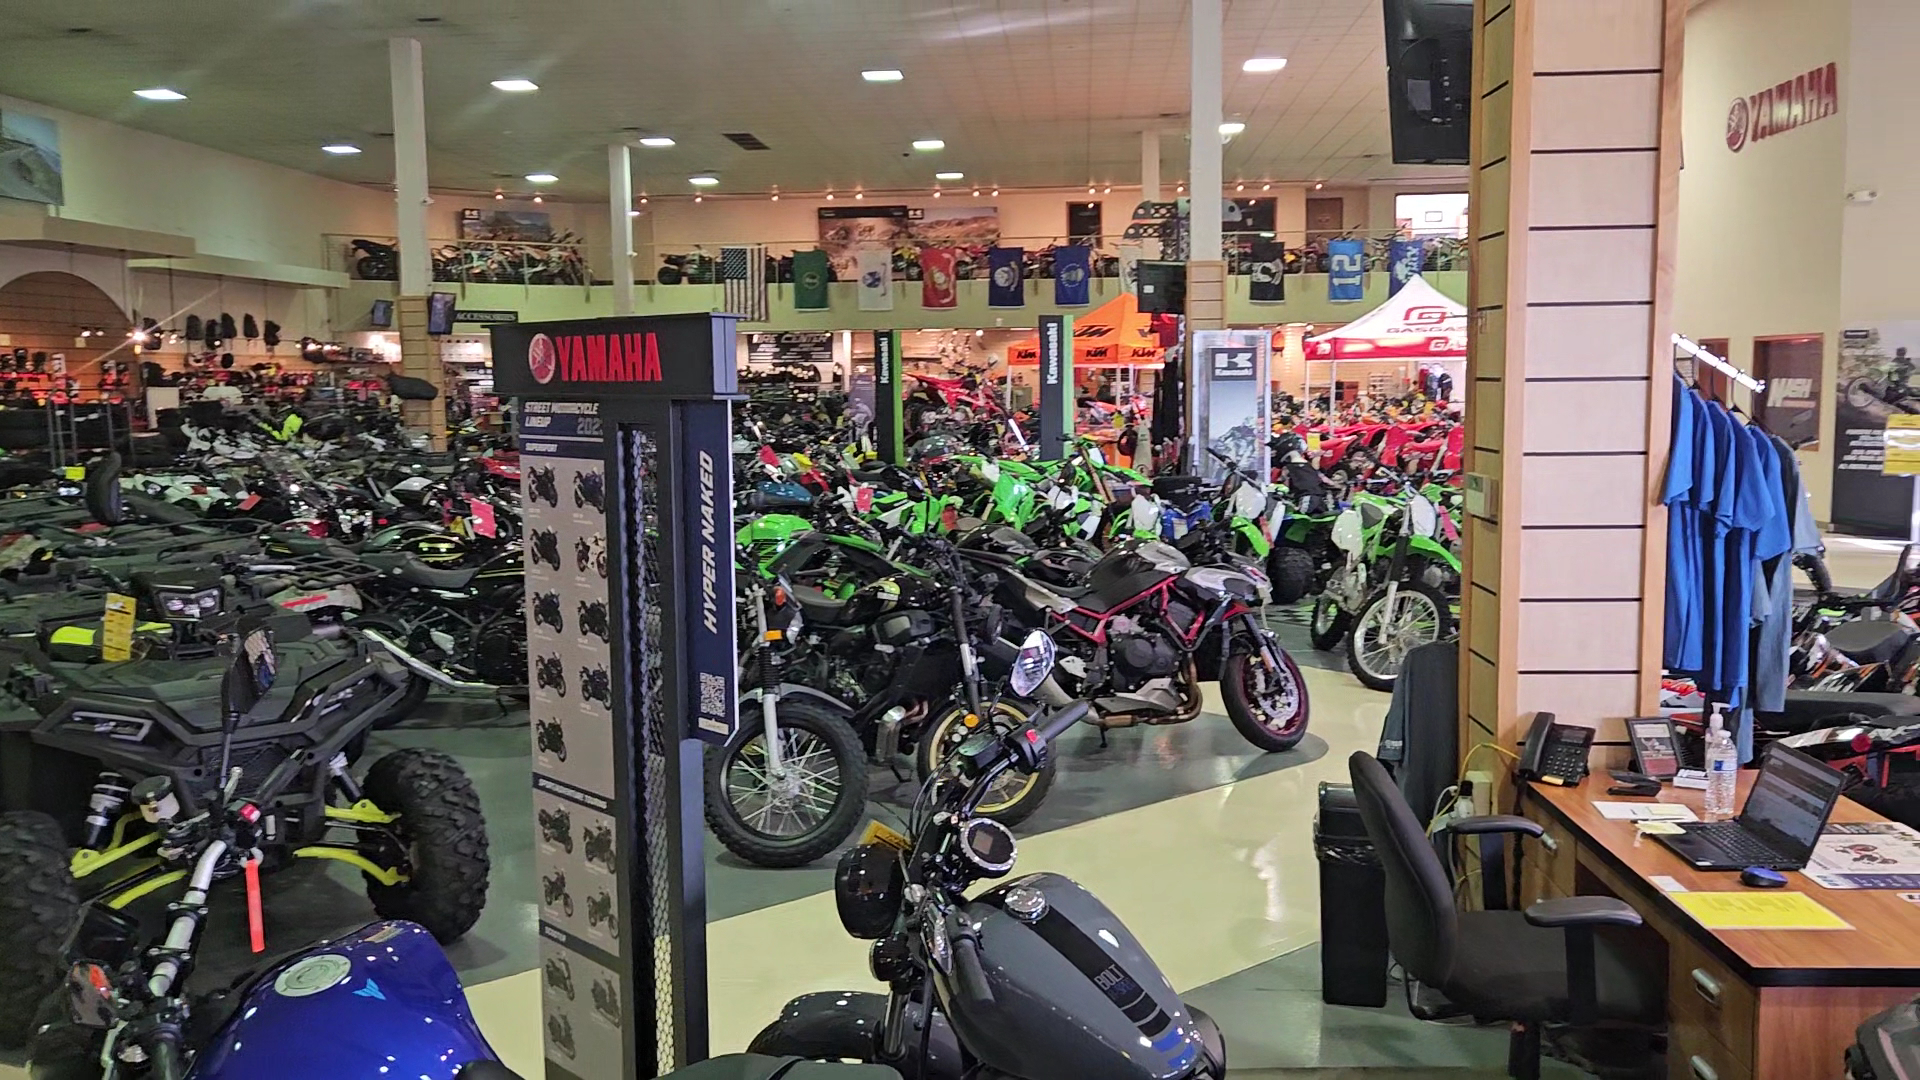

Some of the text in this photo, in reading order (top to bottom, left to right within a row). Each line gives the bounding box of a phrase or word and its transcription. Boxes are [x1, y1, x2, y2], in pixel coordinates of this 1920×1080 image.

[1749, 62, 1838, 143] YAMAHA
[1331, 254, 1362, 286] 12
[555, 332, 662, 381] YAMAHA
[1046, 322, 1058, 385] Kawasaki
[524, 401, 551, 414] STREET
[576, 417, 604, 435] 202
[700, 450, 717, 634] HYPER NAKED
[1093, 963, 1125, 990] BOLT
